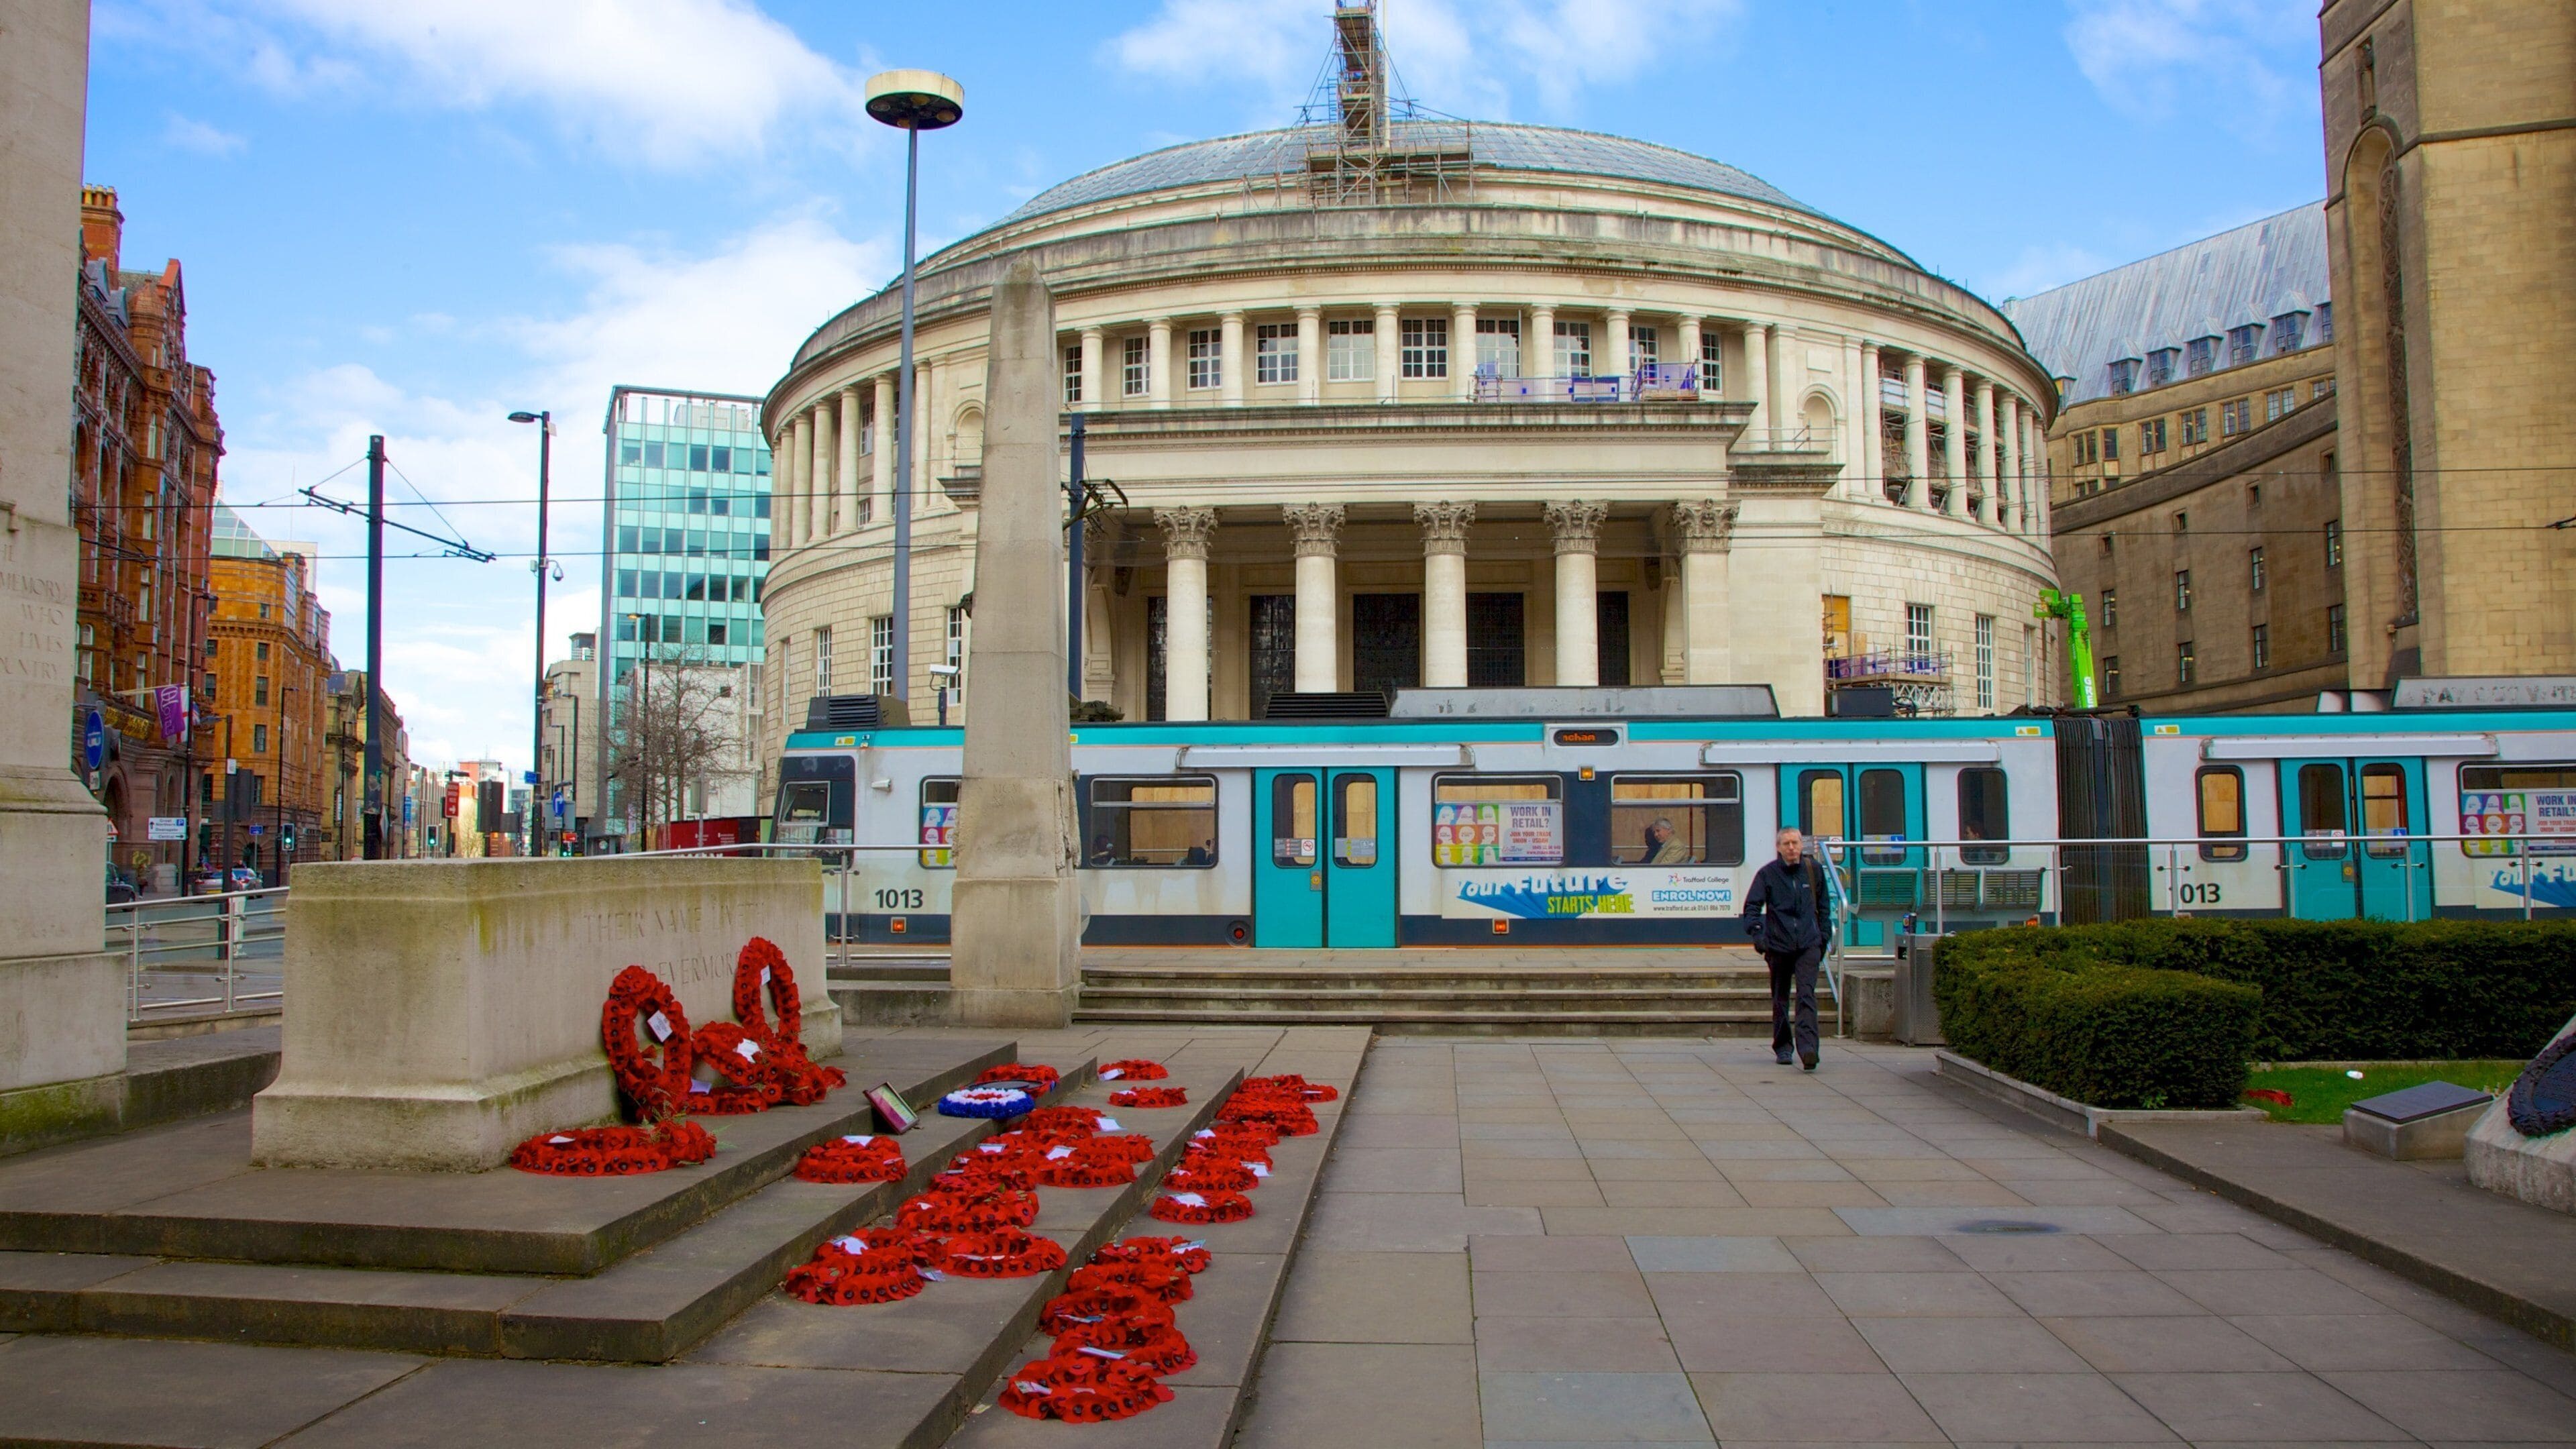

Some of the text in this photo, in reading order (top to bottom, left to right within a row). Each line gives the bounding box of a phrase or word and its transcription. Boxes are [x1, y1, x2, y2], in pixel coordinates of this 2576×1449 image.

[21, 602, 63, 625] WHO
[2536, 795, 2564, 805] WORK
[1510, 806, 1551, 816] WORK IN
[2538, 807, 2575, 817] RETAIL?
[1512, 818, 1550, 828] RETAIL?
[1458, 873, 1628, 898] Your Future
[2168, 883, 2220, 904] 013
[875, 889, 923, 908] 1013
[1548, 894, 1635, 914] STARTS HERE
[1652, 890, 1731, 902] ENROL NOW!
[584, 911, 645, 943] THEIR
[655, 906, 702, 933] NAME
